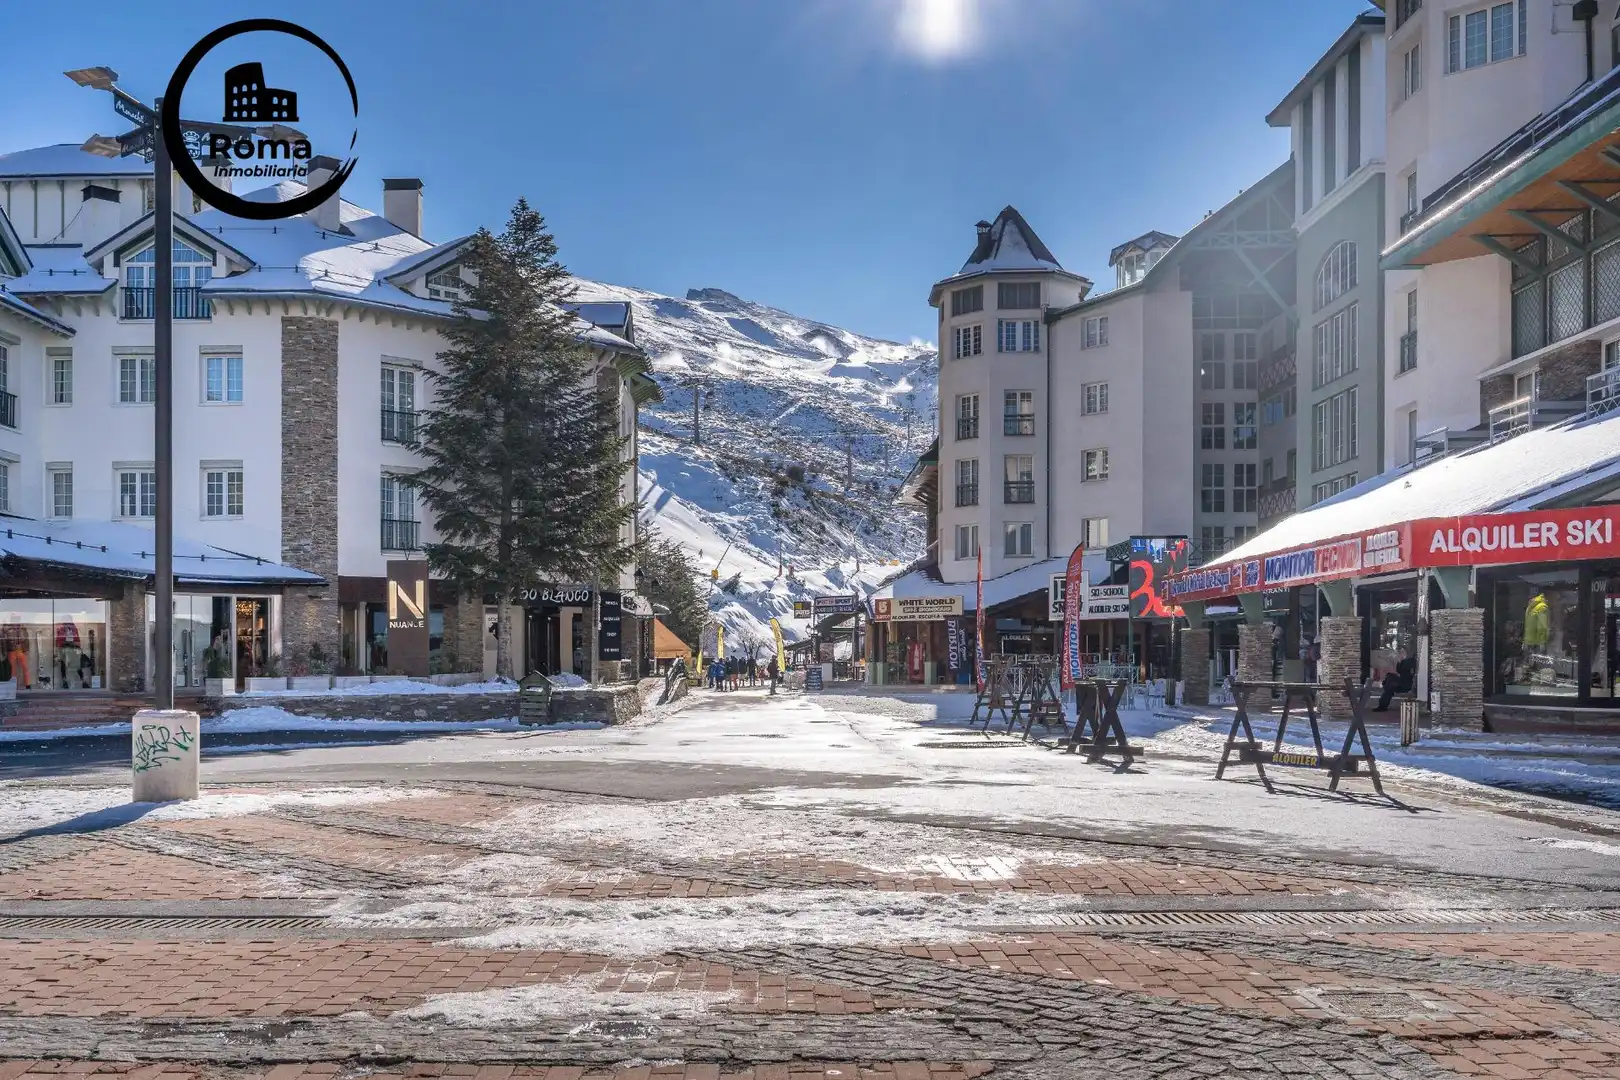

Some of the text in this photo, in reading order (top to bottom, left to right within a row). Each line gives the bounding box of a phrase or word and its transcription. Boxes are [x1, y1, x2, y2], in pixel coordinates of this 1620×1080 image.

[1365, 530, 1400, 551] ALQUILER
[1429, 517, 1613, 553] ALQUILER SKI
[1375, 547, 1401, 565] RENTAL
[388, 579, 425, 620] N
[542, 588, 589, 603] BLANCO
[1103, 587, 1125, 597] SCHOOL
[925, 598, 956, 606] WORLD
[1088, 604, 1112, 614] ALQUILER
[389, 620, 425, 629] NUANCE
[1272, 752, 1318, 767] ALQUILER
